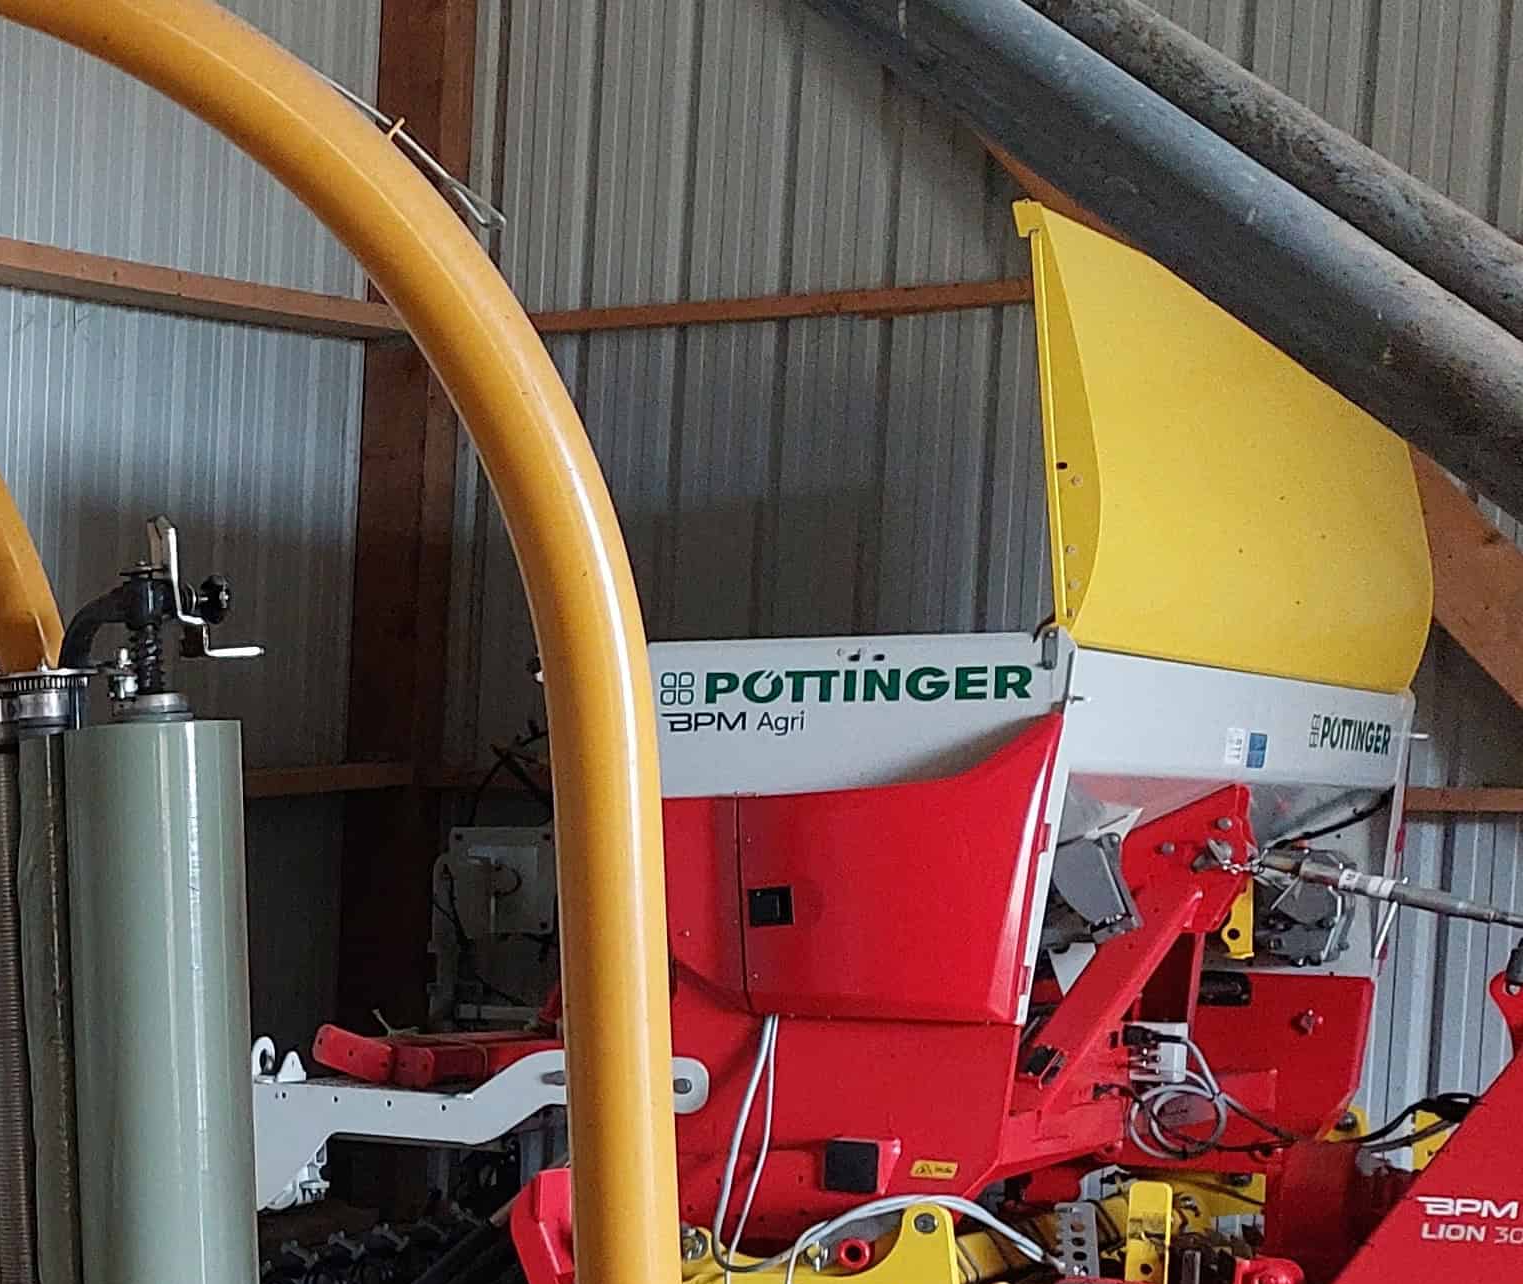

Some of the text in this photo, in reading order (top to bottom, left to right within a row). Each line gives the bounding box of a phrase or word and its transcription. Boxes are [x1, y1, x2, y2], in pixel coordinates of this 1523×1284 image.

[661, 711, 805, 736] BPM Agri
[1416, 1196, 1518, 1219] BPM
[1421, 1222, 1486, 1242] LION
